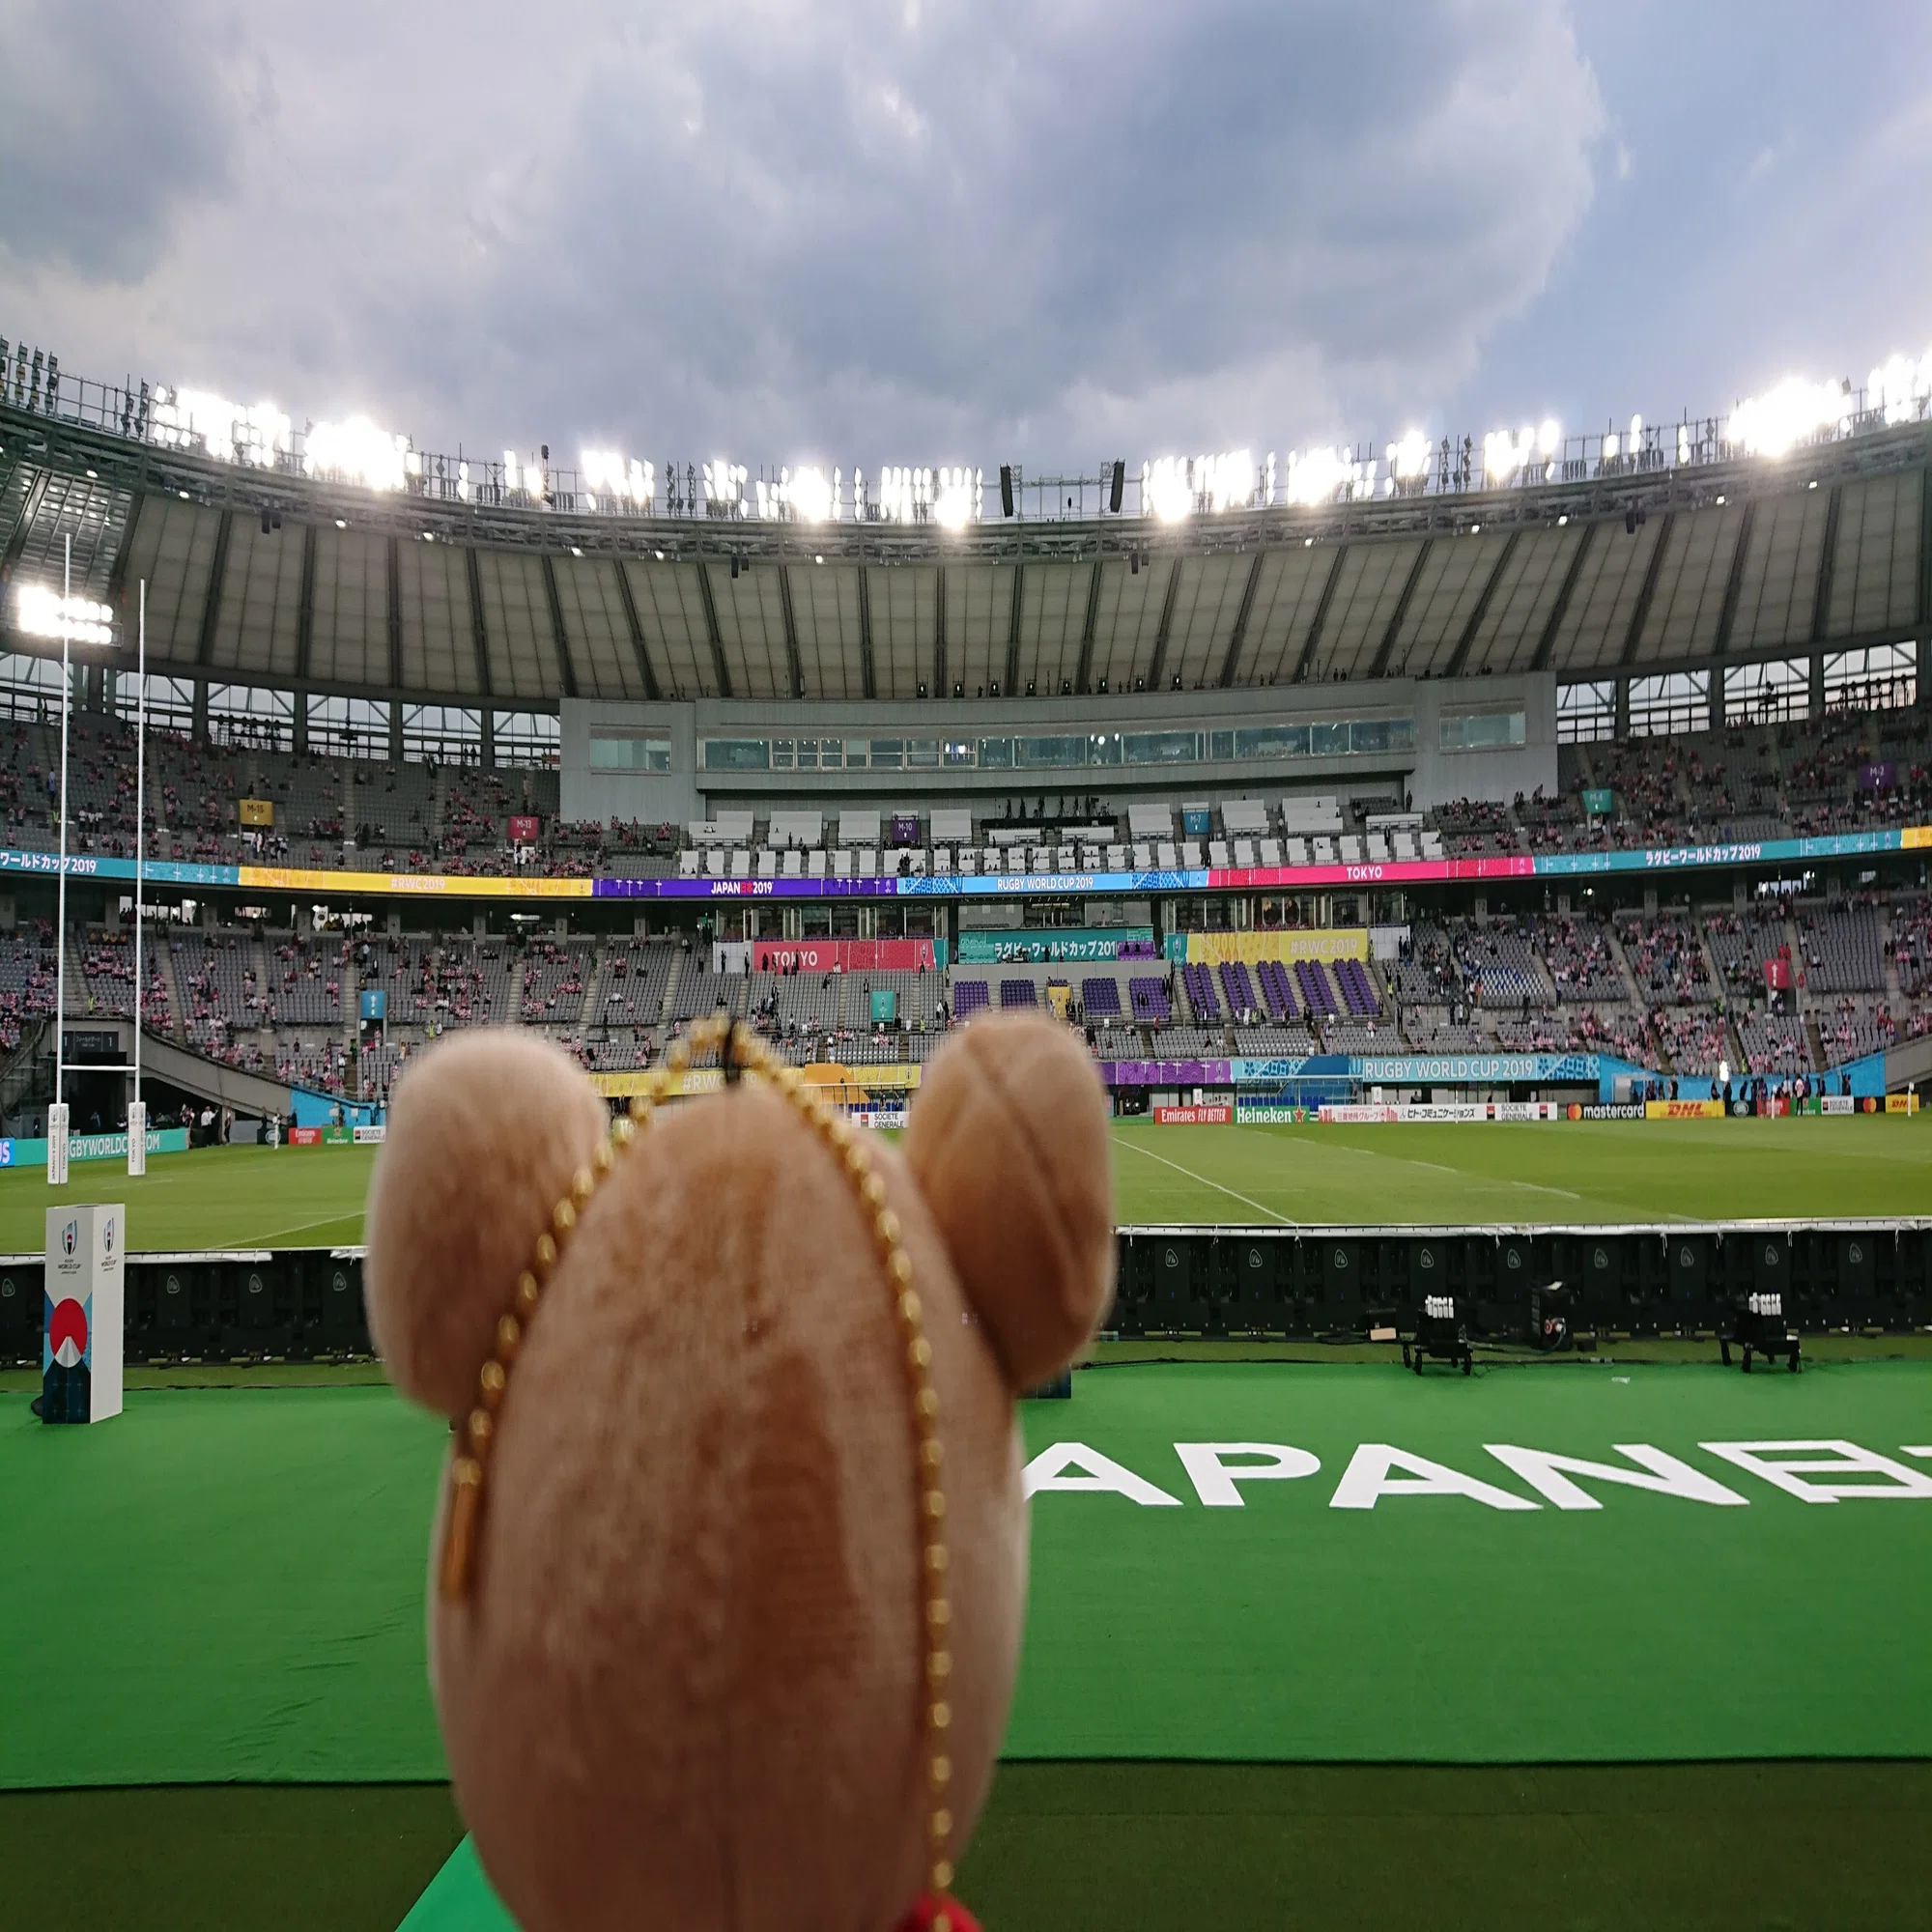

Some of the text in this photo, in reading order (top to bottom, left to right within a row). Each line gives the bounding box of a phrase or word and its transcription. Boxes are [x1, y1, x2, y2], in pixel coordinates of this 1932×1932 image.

[247, 804, 264, 813] M-15
[898, 822, 913, 832] M-10
[1645, 844, 1761, 867] ラグビーワールドカップ2019
[1347, 866, 1382, 879] TOKYO
[390, 877, 445, 890] #RWC2019
[997, 877, 1094, 890] RUGBY WORLD CUP 2019
[994, 940, 1116, 958] ラグビーワールドカップ201
[1291, 938, 1358, 954] #RWC2019
[1365, 1059, 1533, 1079] RUGBY WORLD CUP 2019
[682, 1072, 758, 1092] #RWC19
[1161, 1108, 1226, 1122] Emirates FLY BETTER
[1236, 1107, 1293, 1123] Heineken
[1584, 1103, 1644, 1119] mastercard
[1668, 1103, 1704, 1116] DHL
